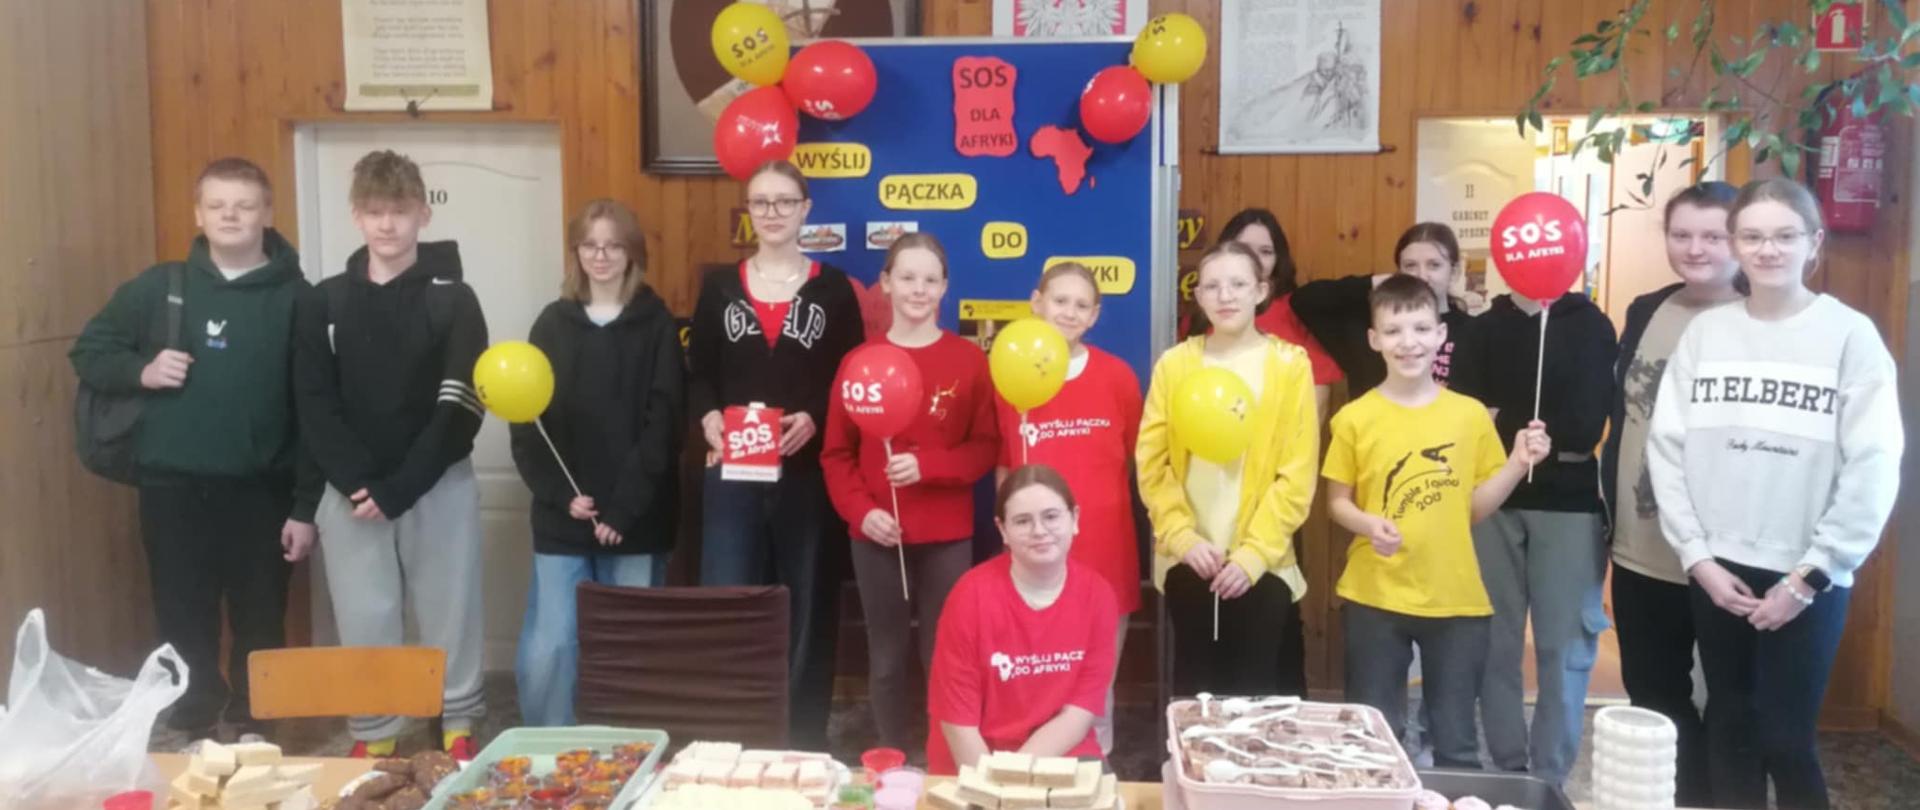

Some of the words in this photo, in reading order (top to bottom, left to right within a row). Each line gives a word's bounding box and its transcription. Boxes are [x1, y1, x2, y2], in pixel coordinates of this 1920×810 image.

[731, 28, 769, 59] SOS
[959, 66, 1008, 88] SOS
[970, 108, 1001, 122] DLA
[960, 133, 1013, 148] AFRYKI
[797, 147, 866, 169] WYŚLIJ
[429, 189, 448, 205] 10
[885, 183, 964, 205] PĄCZKA
[991, 231, 1022, 249] DO
[1502, 219, 1562, 249] SOS
[842, 380, 882, 402] SOS
[728, 423, 773, 450] SOS
